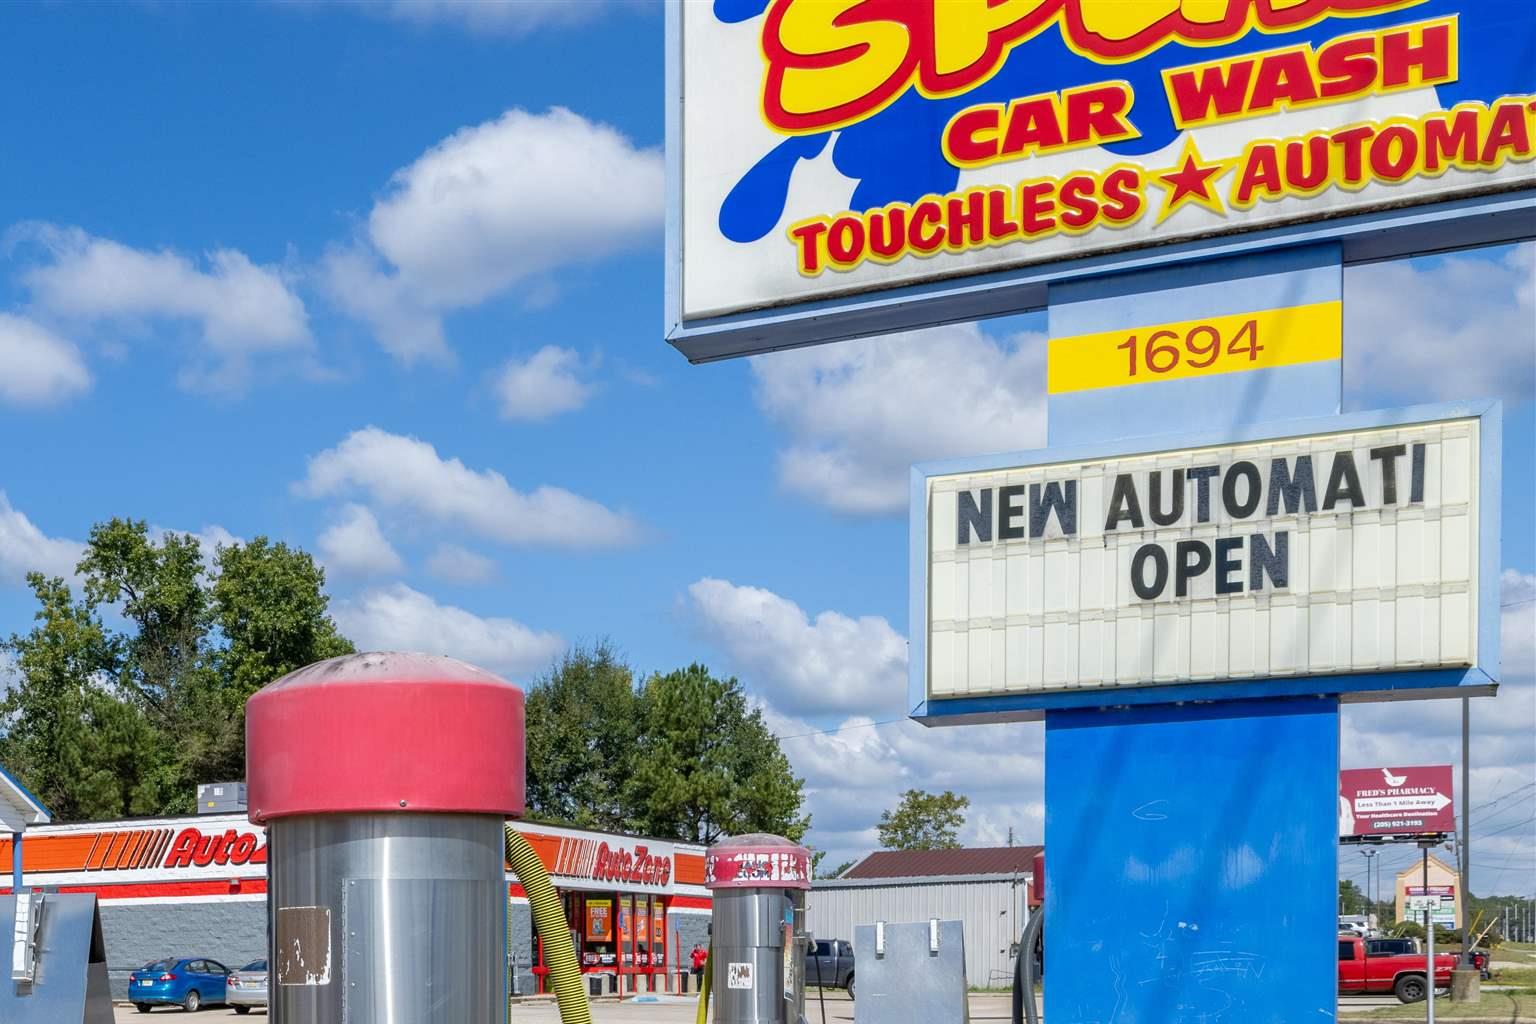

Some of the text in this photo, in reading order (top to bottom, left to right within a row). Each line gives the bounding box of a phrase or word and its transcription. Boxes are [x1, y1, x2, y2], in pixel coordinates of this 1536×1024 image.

[944, 86, 1136, 161] CAR
[1169, 23, 1452, 123] WASH
[792, 101, 1536, 274] TOUCHLESS AUTOMA
[1116, 319, 1265, 377] 1694
[956, 443, 1427, 545] NEW AUTOMATI
[1130, 530, 1289, 600] OPEN
[1356, 787, 1436, 797] FRED'S PHARMACY
[1416, 799, 1436, 807] Away
[163, 827, 268, 868] Auto
[592, 840, 672, 887] AutoZone
